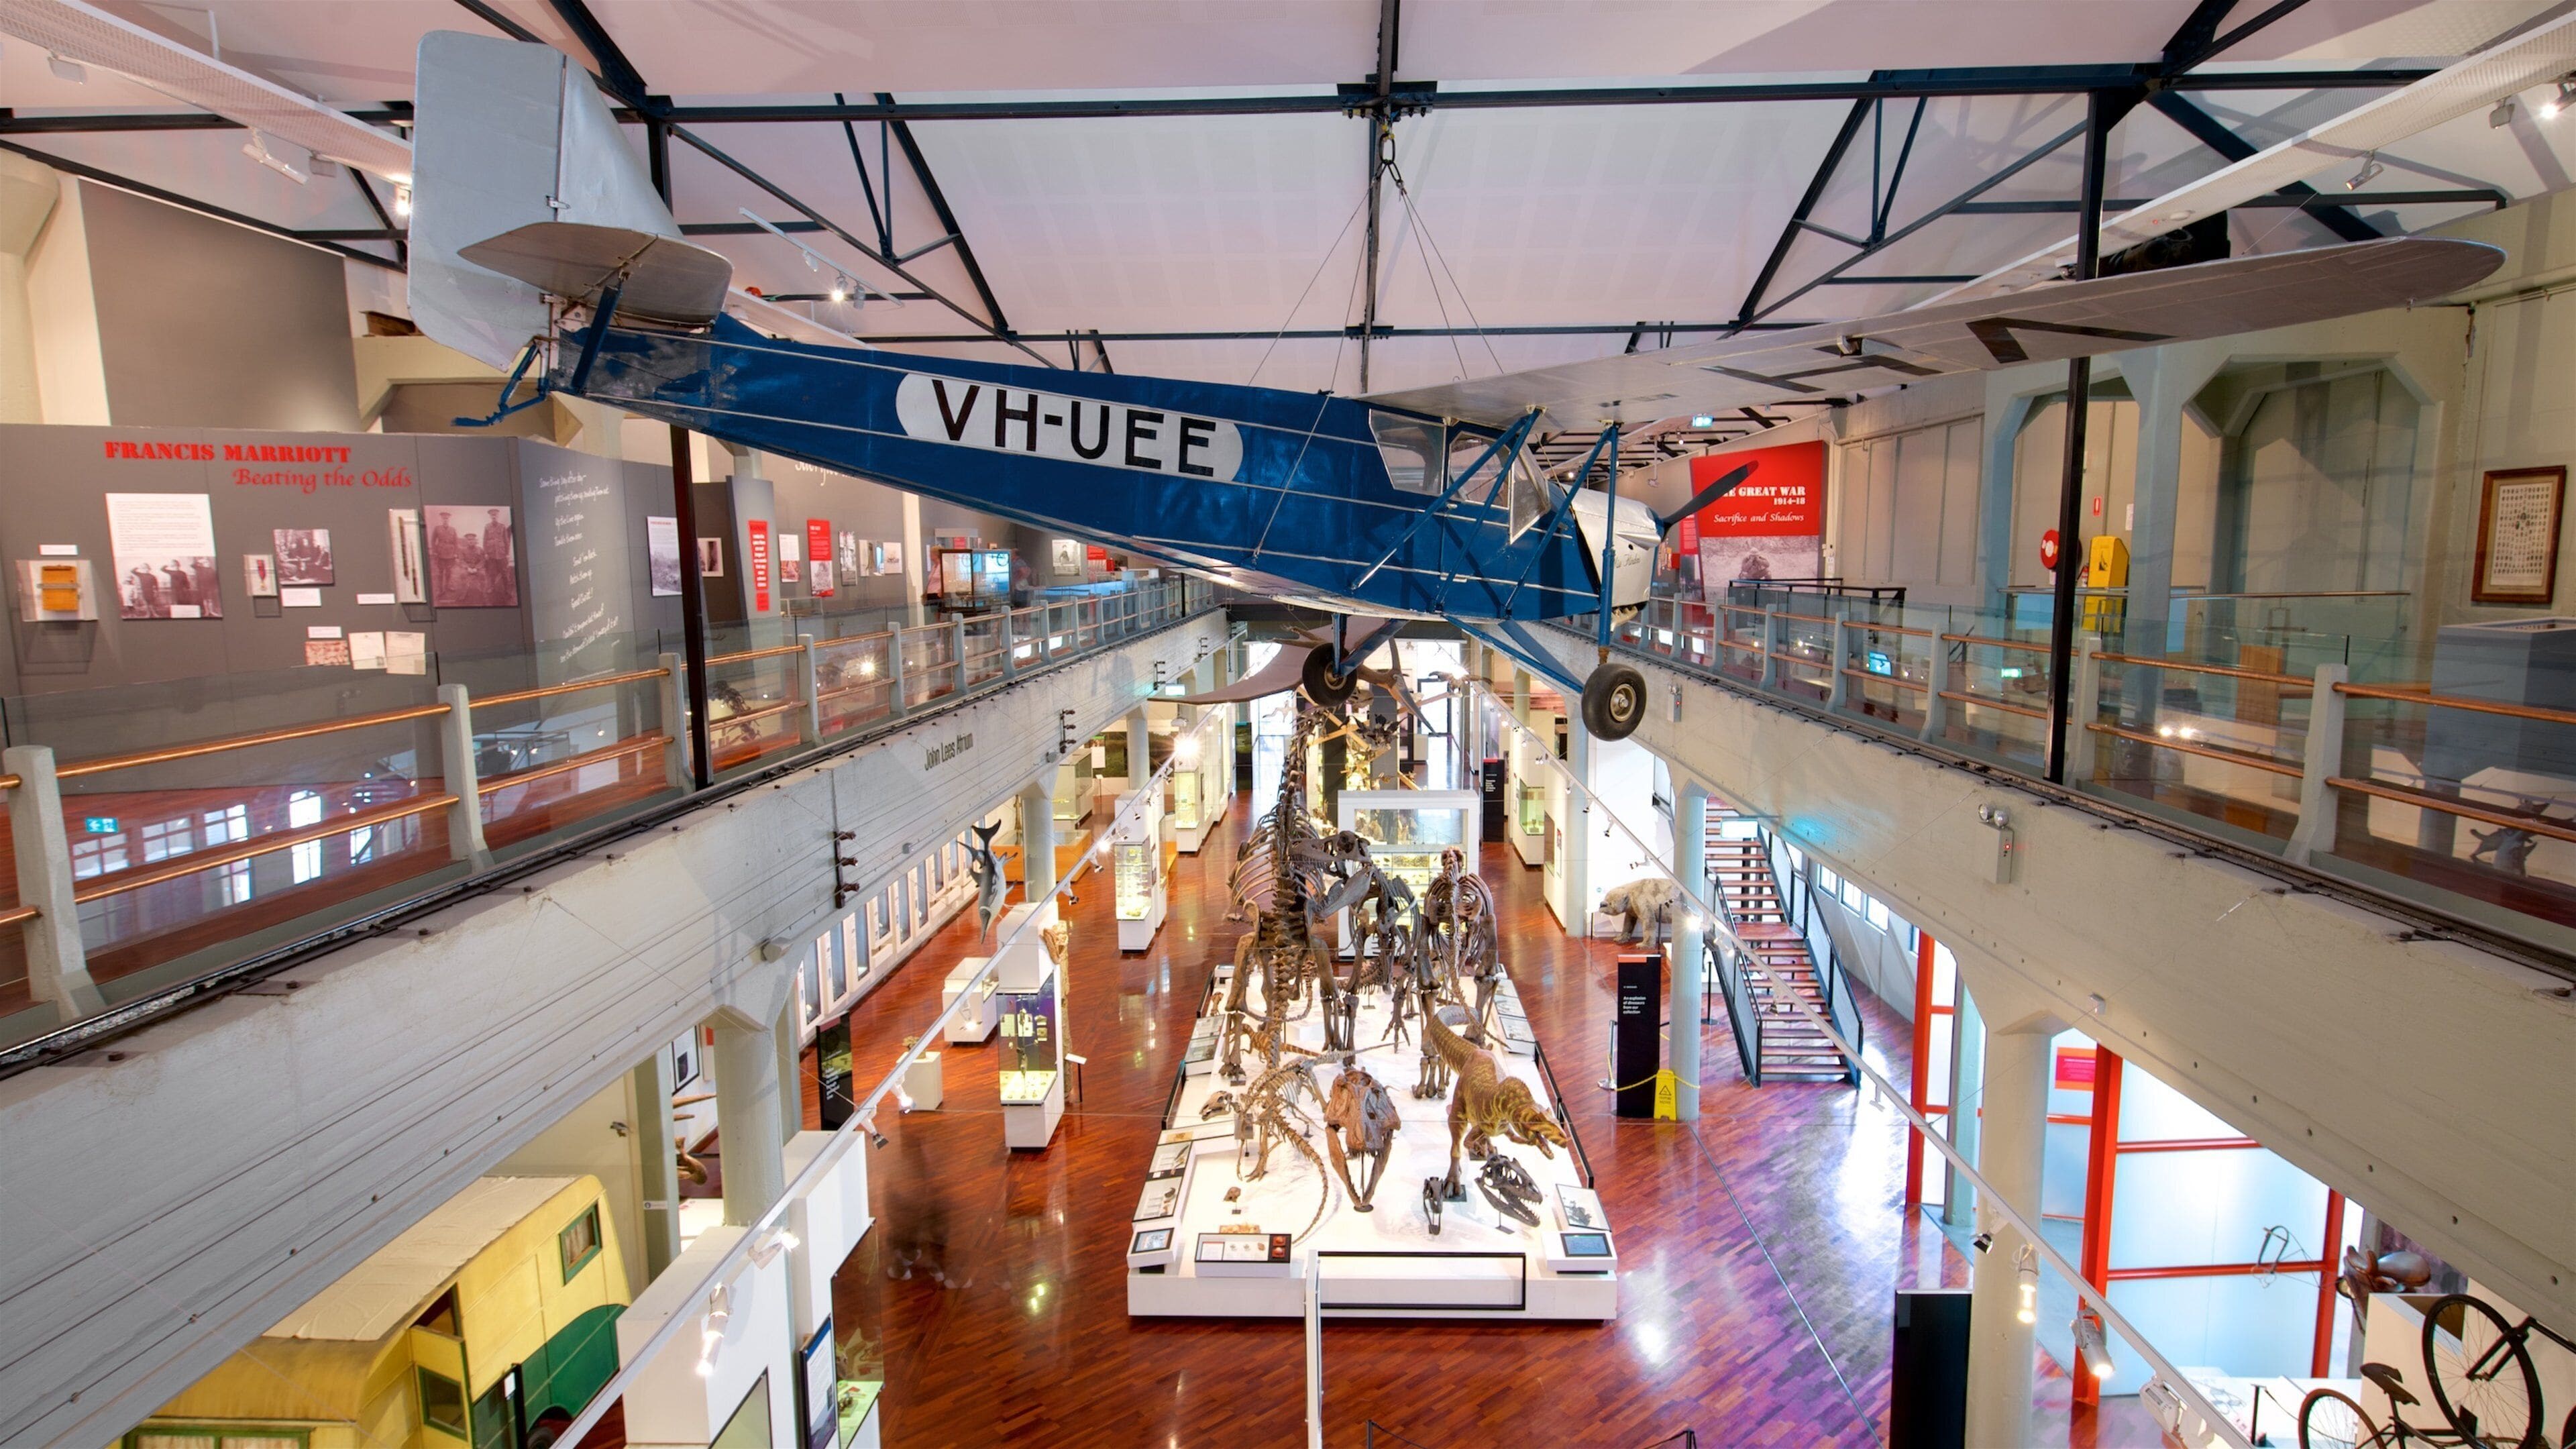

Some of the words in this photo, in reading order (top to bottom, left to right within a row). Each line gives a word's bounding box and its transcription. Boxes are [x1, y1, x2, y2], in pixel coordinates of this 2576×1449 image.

[932, 379, 1217, 477] VH-UEE
[105, 441, 215, 461] FRANCIS
[223, 444, 352, 463] MARRIOTT
[232, 468, 317, 494] Beating
[324, 466, 355, 487] the
[362, 467, 413, 488] Odds
[1739, 486, 1778, 496] GREAT
[1780, 486, 1806, 496] WAR
[1713, 512, 1748, 526] Sacrifice
[1750, 512, 1769, 523] and
[1770, 511, 1805, 523] Shadows
[924, 746, 941, 771] John
[941, 742, 955, 762] Lees
[957, 733, 973, 755] Atrium
